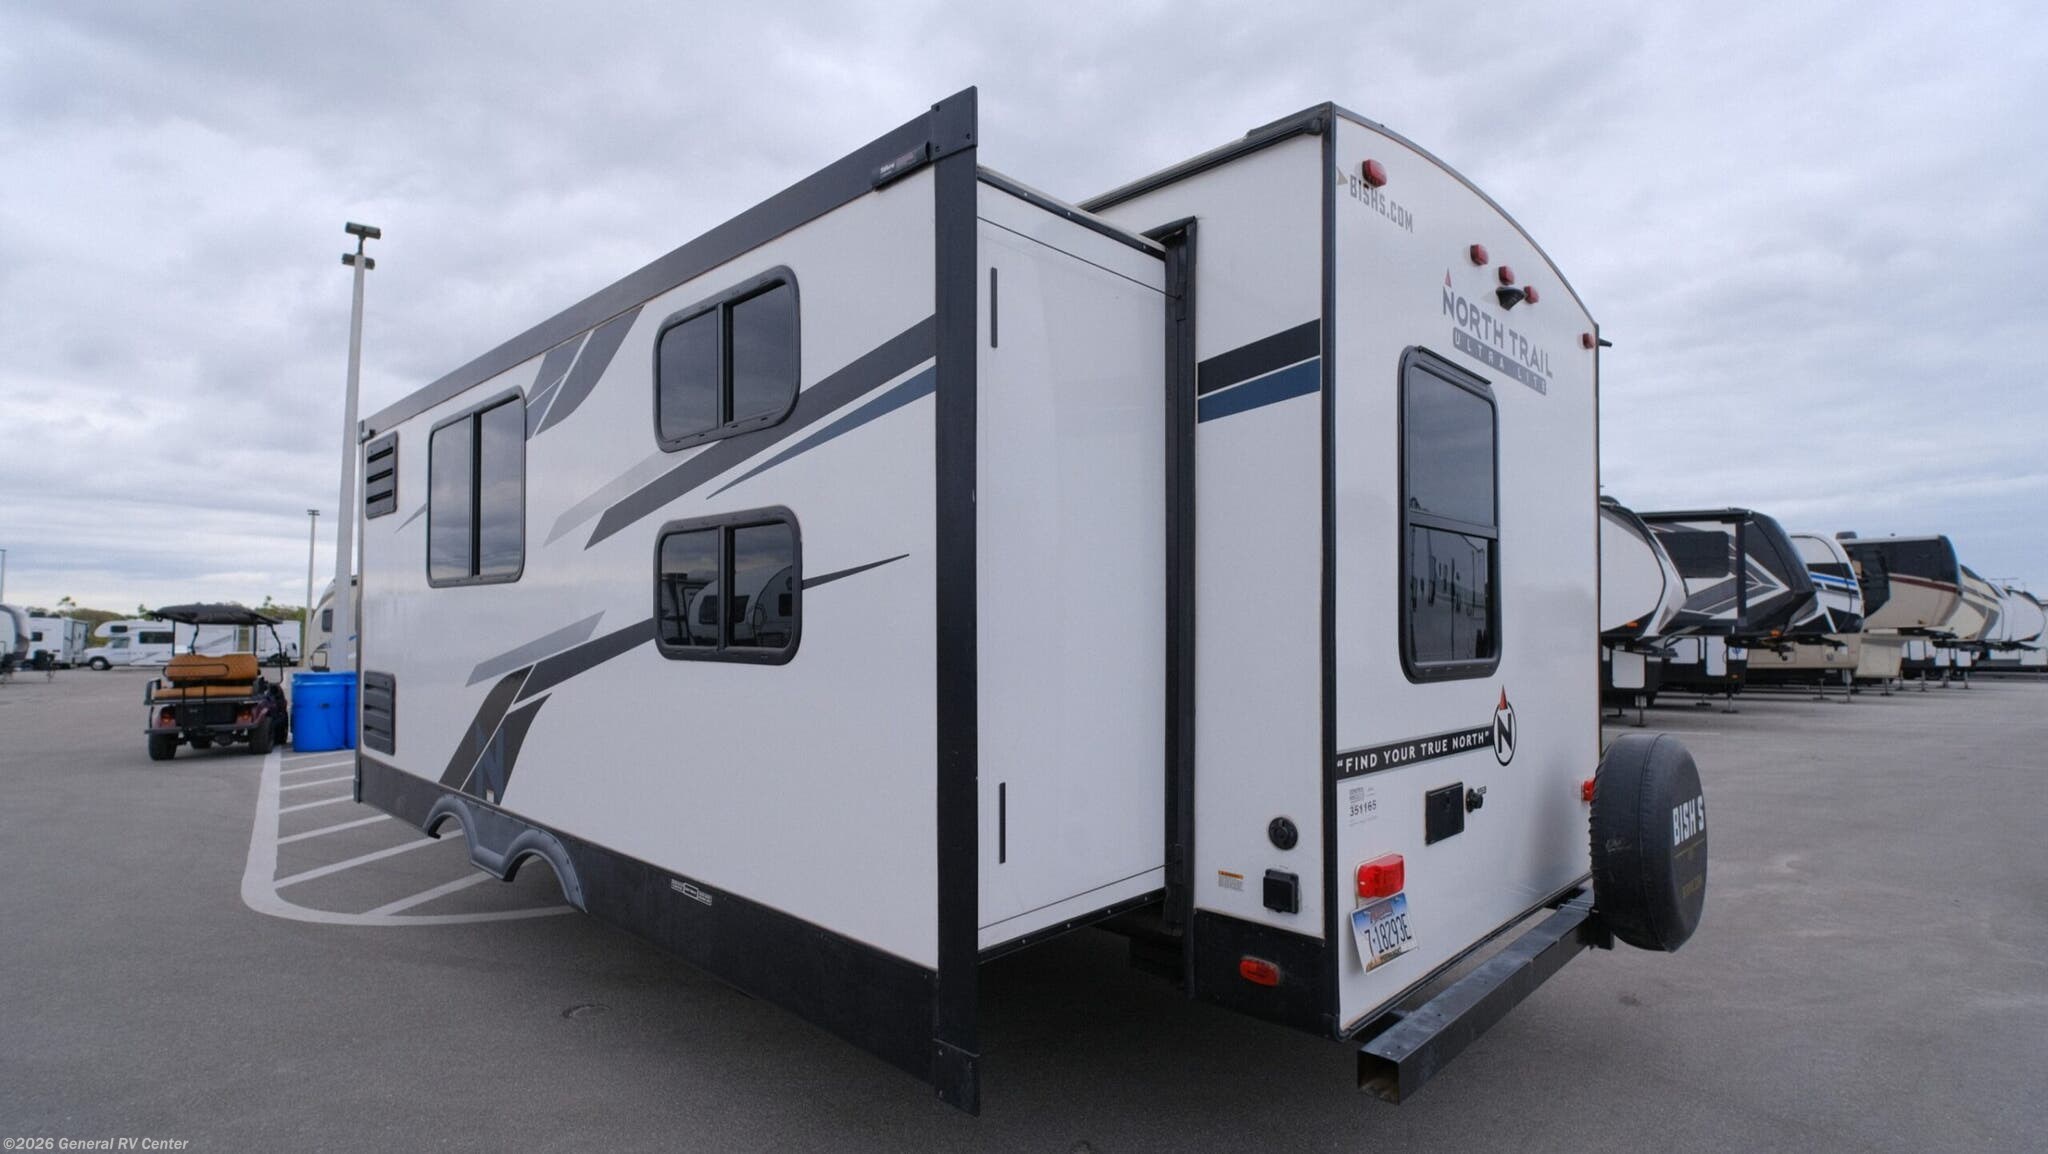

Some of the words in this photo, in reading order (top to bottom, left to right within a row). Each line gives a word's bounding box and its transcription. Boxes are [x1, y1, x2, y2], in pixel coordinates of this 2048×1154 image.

[1350, 174, 1413, 233] BISHS.COM
[1443, 286, 1504, 349] NORTH
[1509, 328, 1553, 379] TRAIL
[1455, 330, 1506, 371] ULTRA
[1518, 367, 1546, 393] LITE
[1383, 745, 1416, 765] YOUR
[1420, 739, 1448, 756] TRUE
[1349, 799, 1377, 817] 351165
